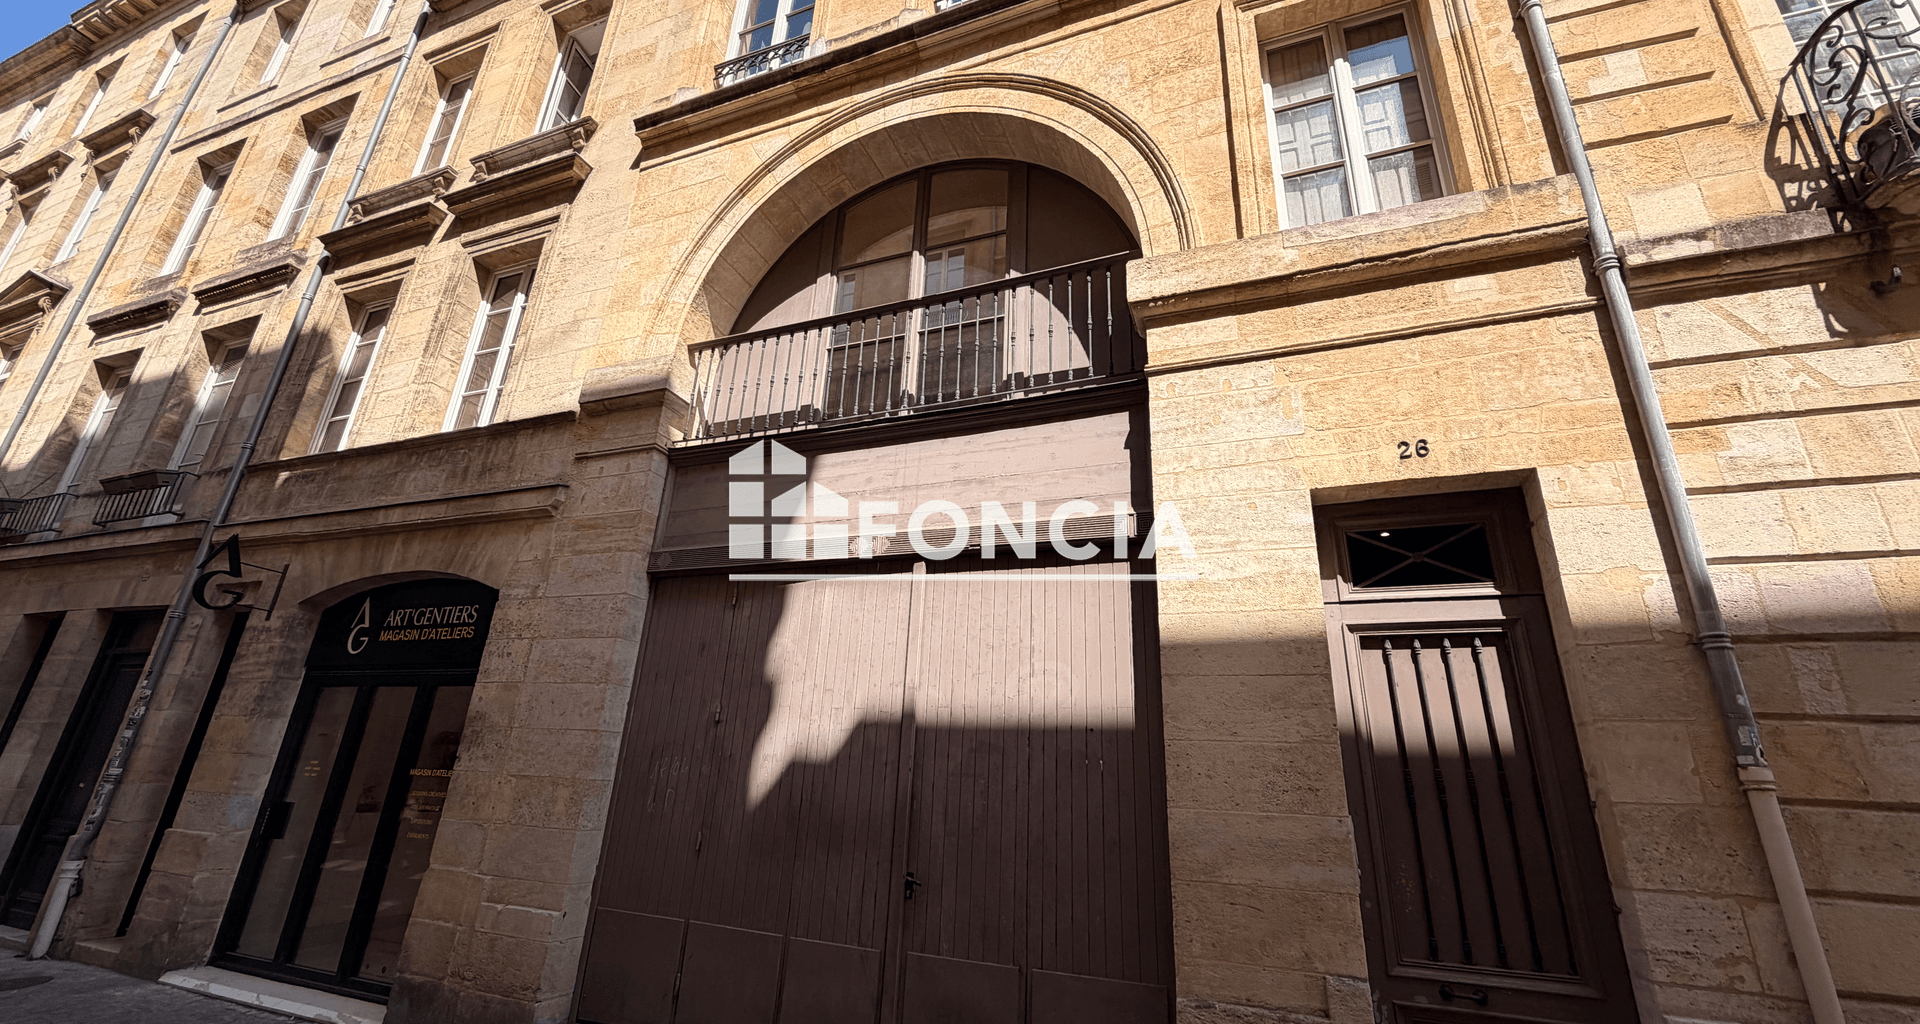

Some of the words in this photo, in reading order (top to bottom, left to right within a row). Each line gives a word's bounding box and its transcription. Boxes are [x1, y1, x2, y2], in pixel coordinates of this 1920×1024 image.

[1397, 439, 1430, 460] 26
[383, 604, 480, 627] ART'GENTIERS
[378, 628, 421, 642] MAGASIN
[420, 626, 475, 640] D'ATELIERS
[409, 768, 431, 776] MAGASIN
